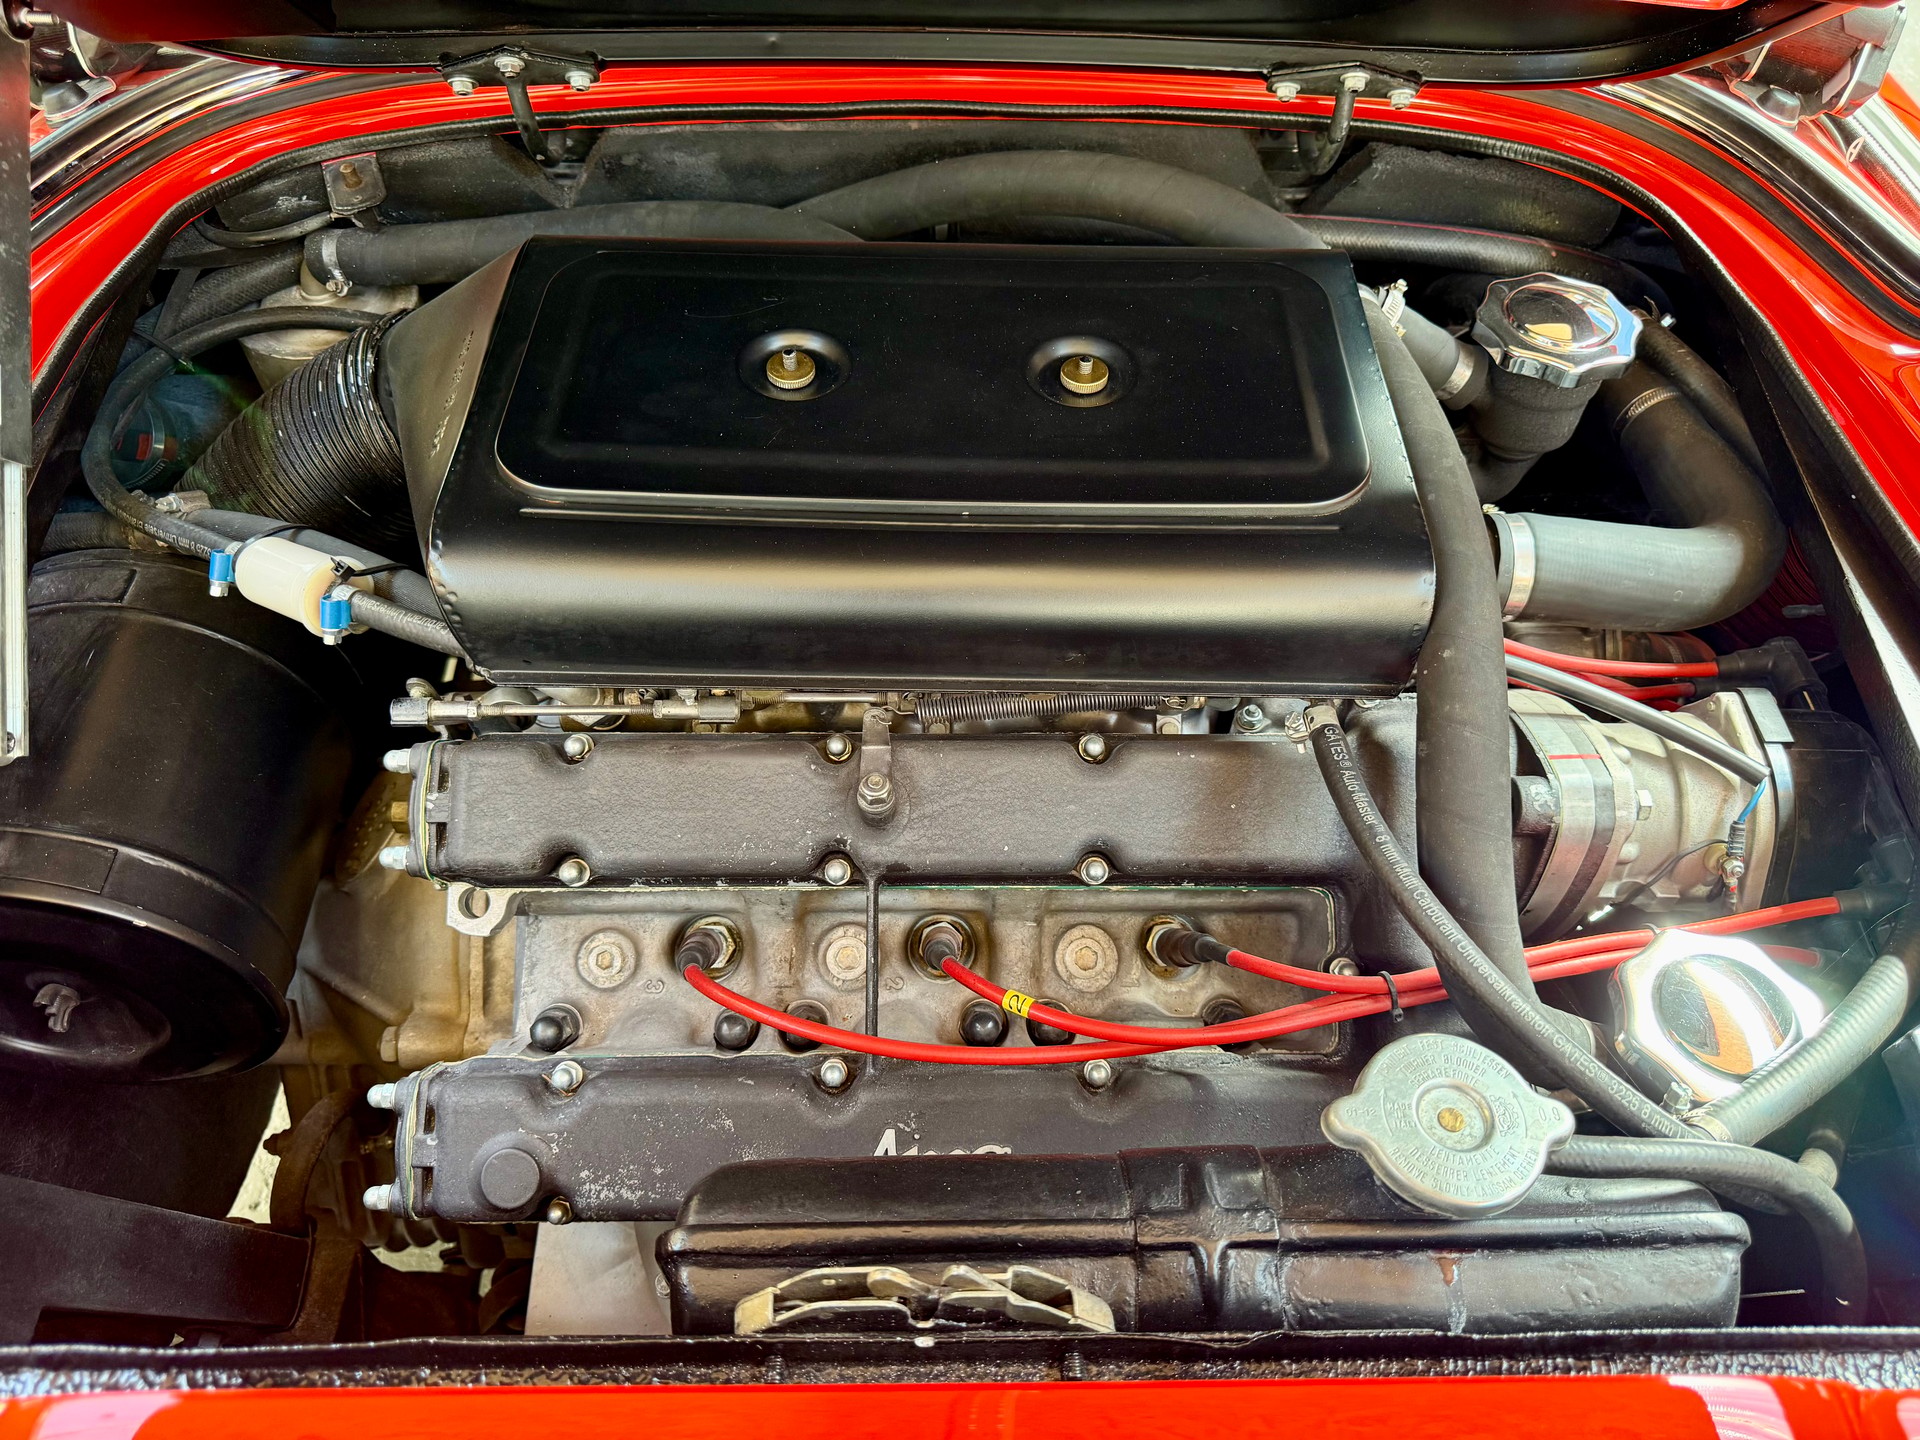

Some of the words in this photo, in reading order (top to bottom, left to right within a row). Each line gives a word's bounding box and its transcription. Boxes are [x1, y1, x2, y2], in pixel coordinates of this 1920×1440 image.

[178, 536, 190, 548] mm
[1375, 834, 1391, 843] 8
[1380, 842, 1400, 863] mm
[1393, 862, 1421, 890] Multi
[1413, 889, 1464, 943] Carburant
[1008, 994, 1027, 1014] 2
[1608, 1081, 1640, 1111] 3225
[1641, 1103, 1652, 1118] 8
[1650, 1113, 1675, 1137] mm
